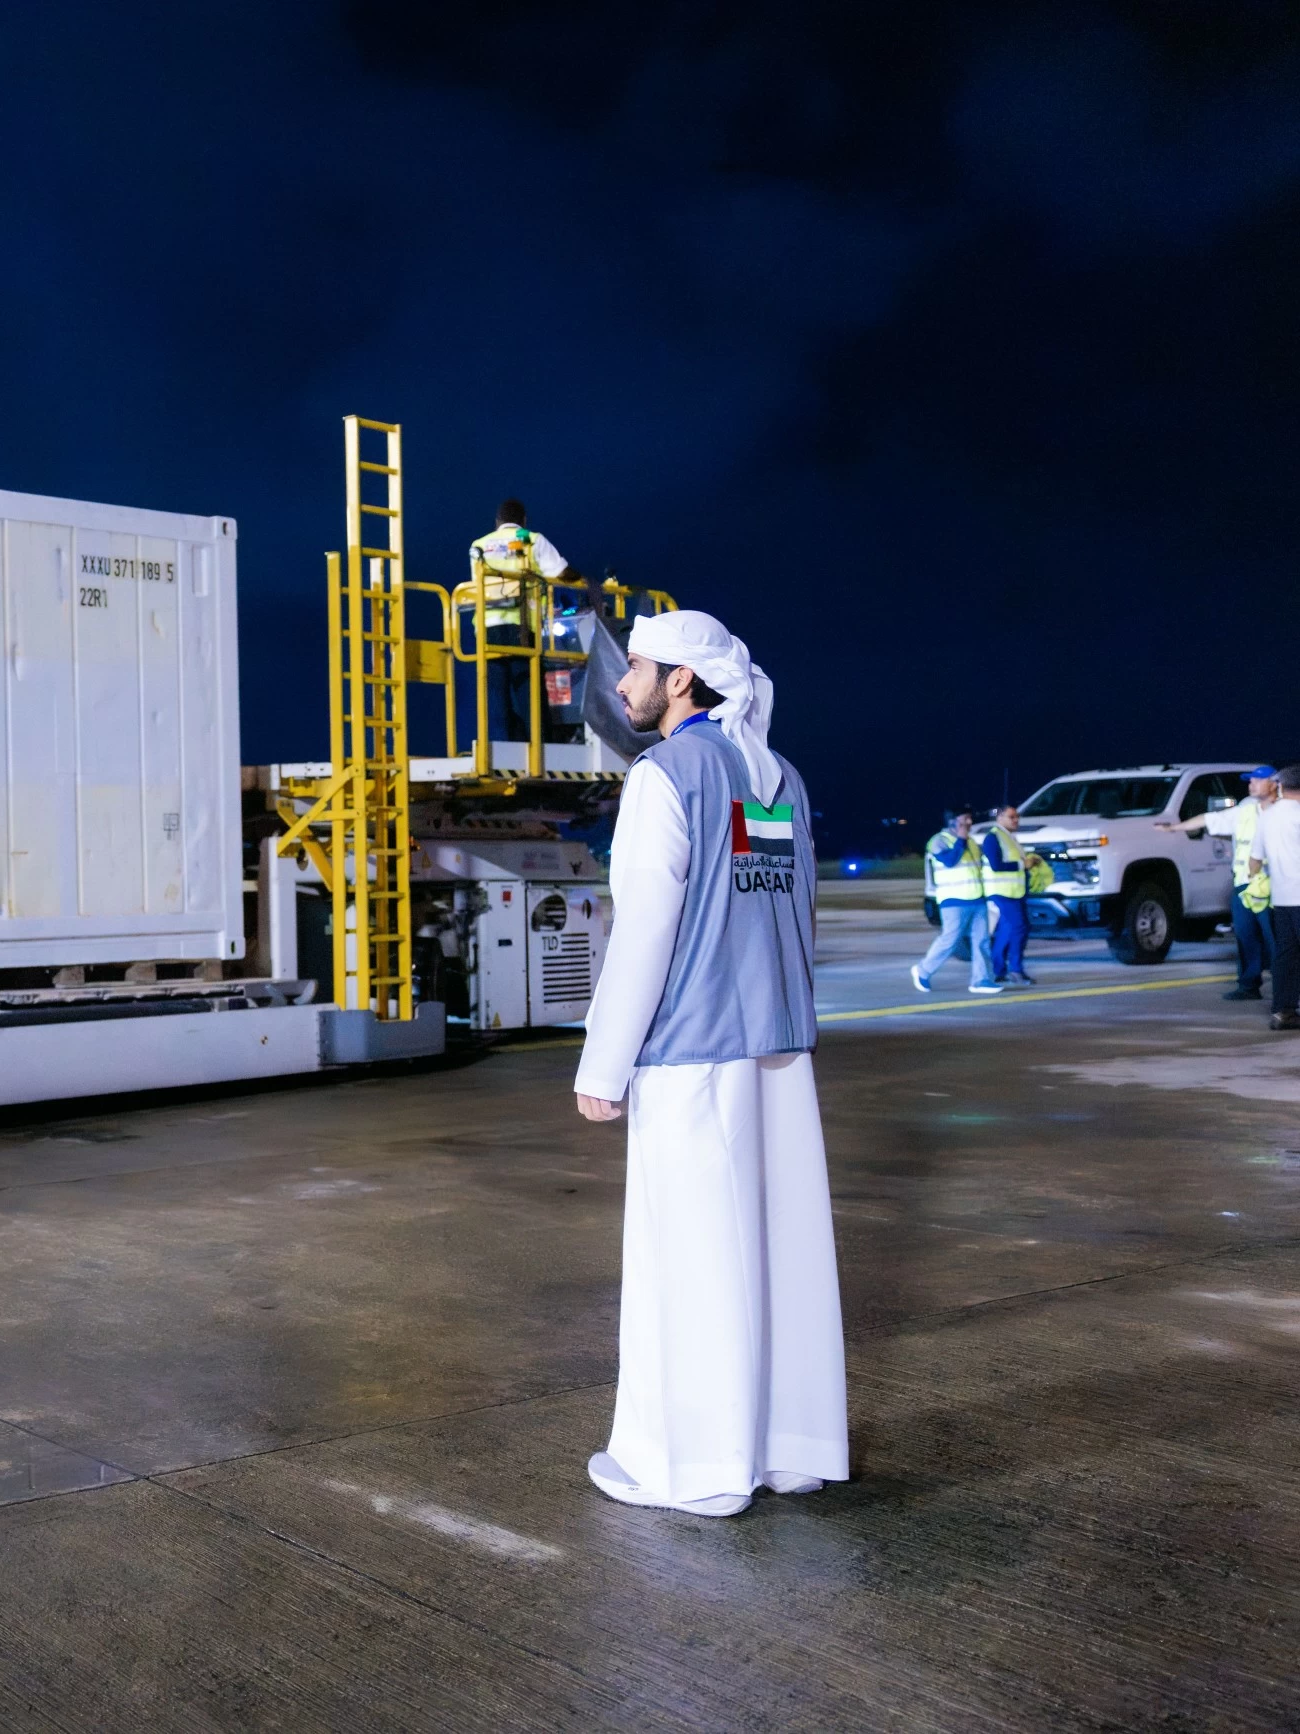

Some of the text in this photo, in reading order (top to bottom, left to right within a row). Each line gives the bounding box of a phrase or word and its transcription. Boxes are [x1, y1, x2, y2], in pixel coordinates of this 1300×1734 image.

[81, 555, 110, 576] XXXU
[167, 564, 174, 582] 5
[80, 588, 107, 607] 22R1
[542, 936, 558, 950] TLD
